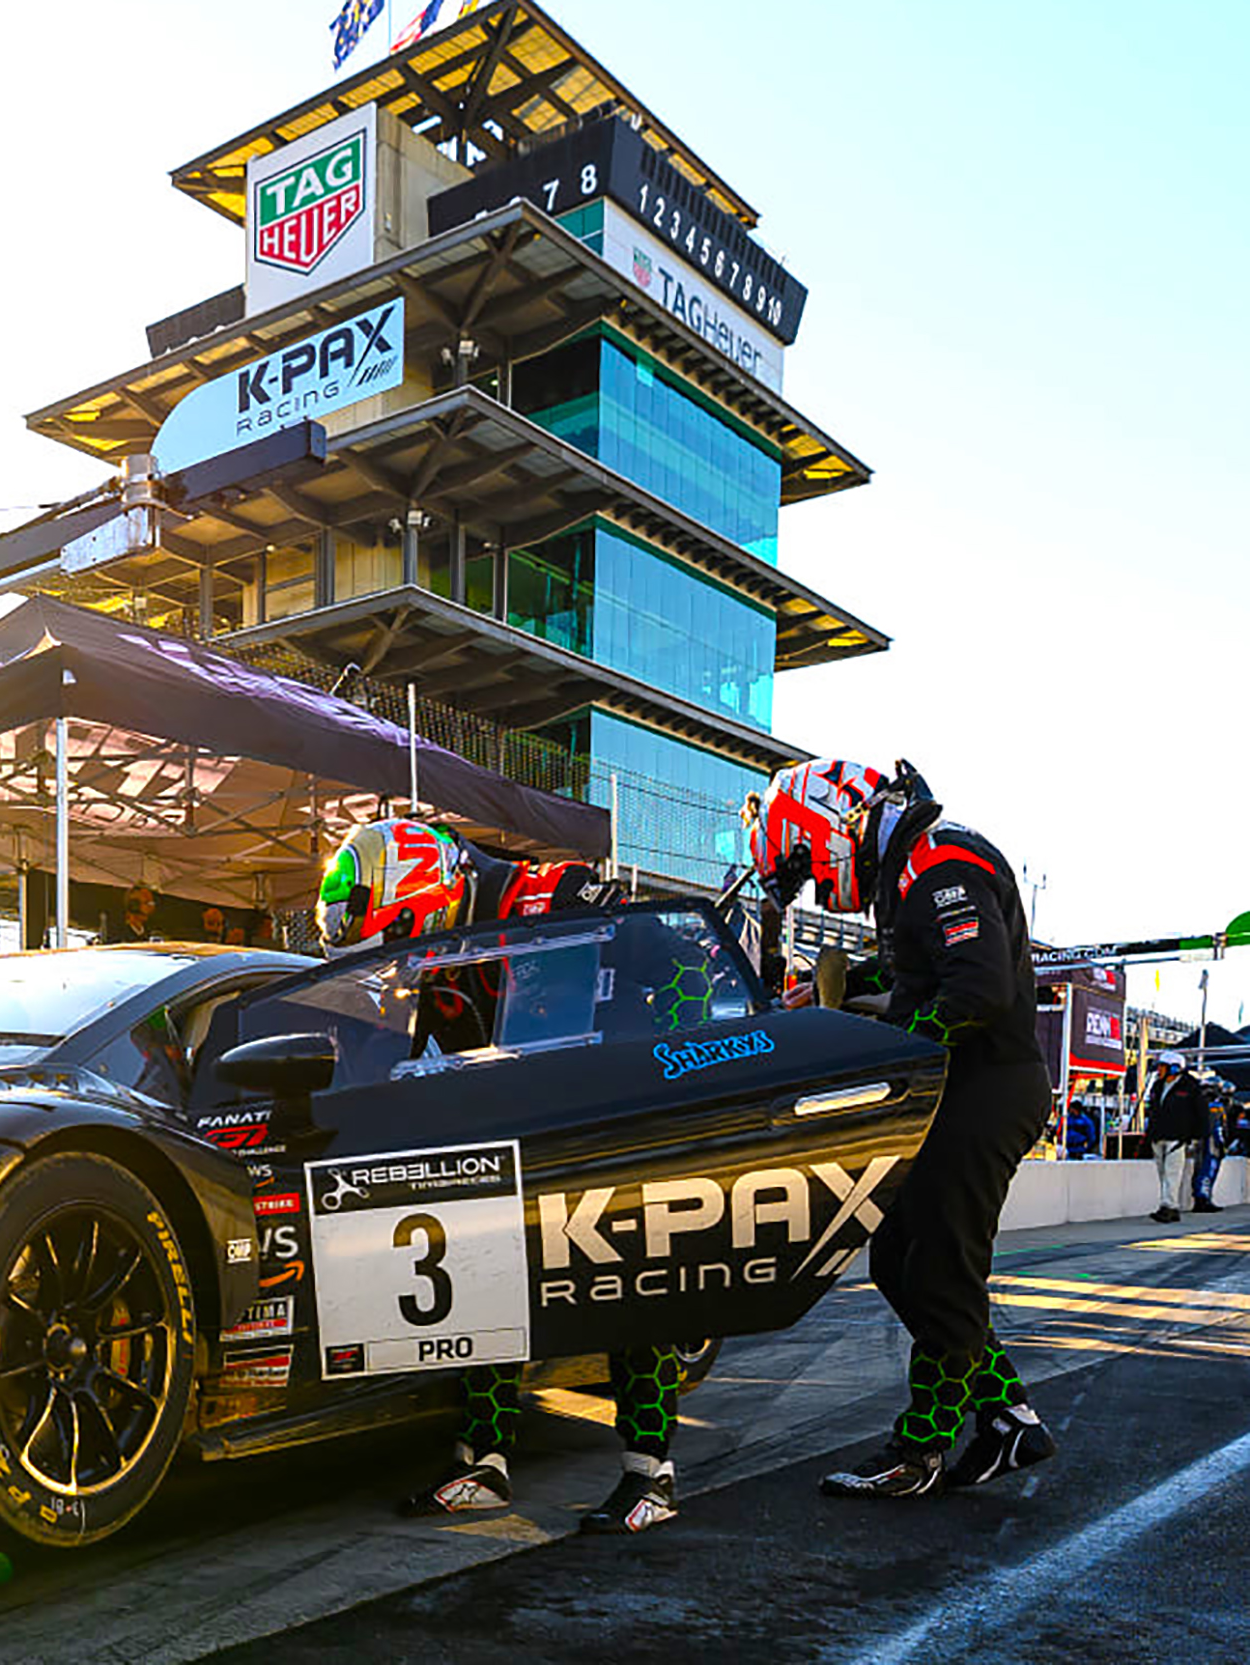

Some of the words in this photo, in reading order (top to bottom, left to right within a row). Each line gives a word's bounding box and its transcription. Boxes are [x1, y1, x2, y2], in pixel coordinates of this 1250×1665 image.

[262, 189, 358, 264] HEUER
[265, 147, 353, 216] TAG
[543, 178, 560, 212] 7
[580, 164, 598, 196] 8
[640, 184, 649, 213] 1
[654, 198, 666, 228] 2
[670, 211, 682, 240] 3
[684, 226, 696, 254] 4
[700, 238, 711, 266] 5
[714, 250, 726, 278] 6
[728, 262, 740, 290] 7
[742, 274, 753, 301] 8
[756, 286, 767, 313] 9
[768, 296, 782, 328] 10
[237, 305, 395, 414] K-PAX
[538, 1155, 902, 1281] K-PAX
[392, 1212, 453, 1327] 3
[418, 1336, 474, 1362] PRO
